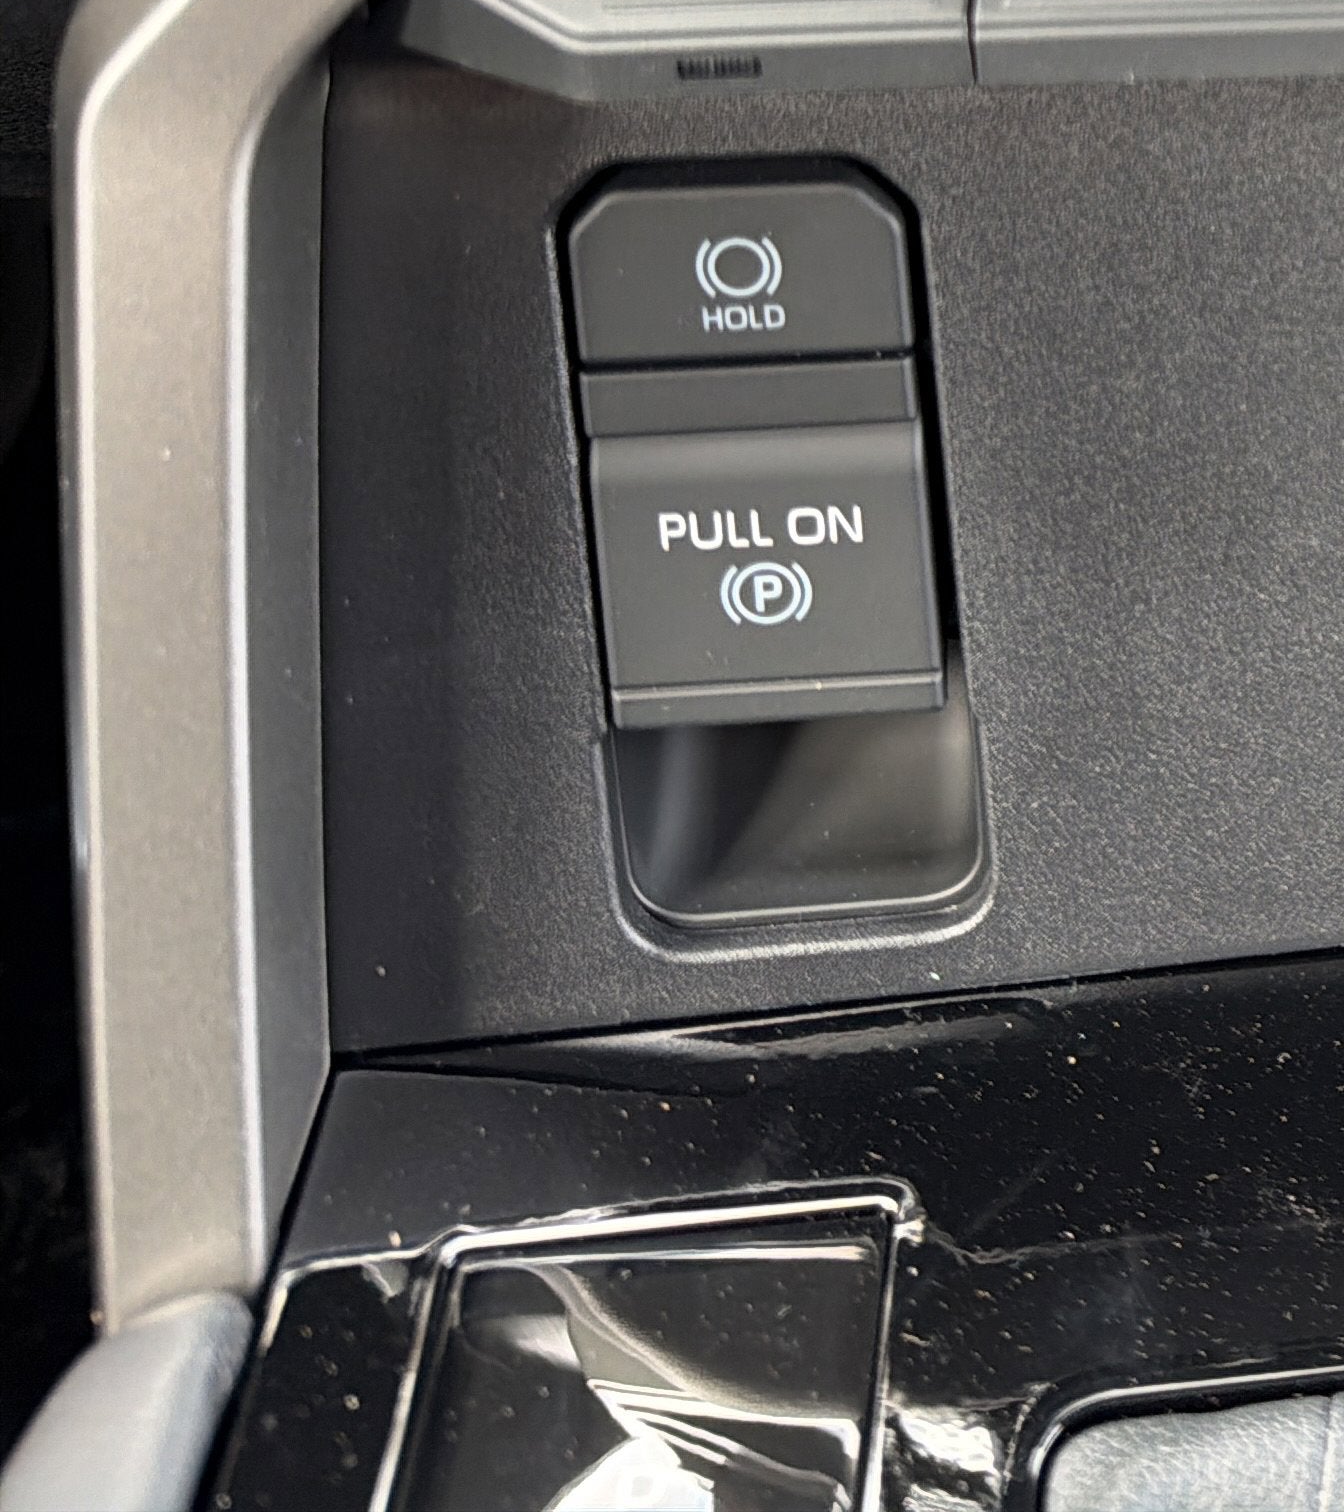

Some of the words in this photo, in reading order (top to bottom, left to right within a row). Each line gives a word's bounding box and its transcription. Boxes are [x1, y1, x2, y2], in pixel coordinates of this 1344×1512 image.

[701, 303, 786, 333] HOLD
[657, 510, 775, 552] PULL
[787, 503, 864, 546] ON
